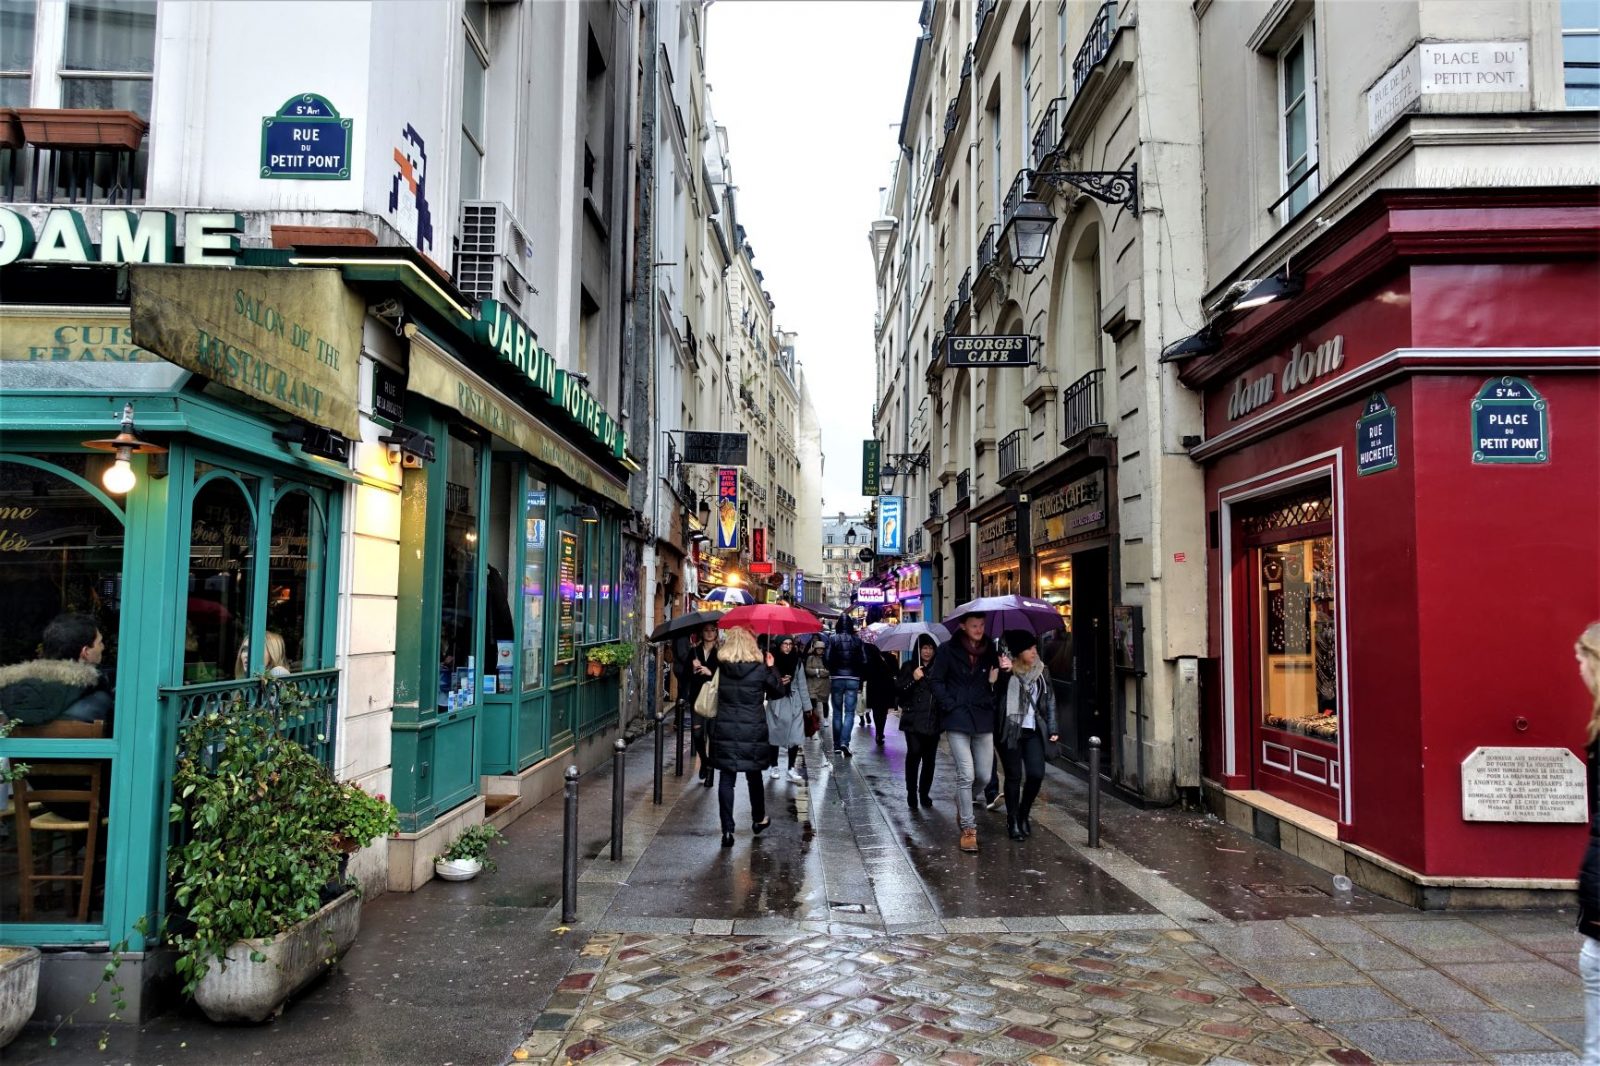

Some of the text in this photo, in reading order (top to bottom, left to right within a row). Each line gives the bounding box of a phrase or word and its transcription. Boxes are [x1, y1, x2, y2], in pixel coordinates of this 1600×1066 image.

[1434, 51, 1515, 65] PLACE DU
[1374, 64, 1411, 103] RUE DE LA
[1434, 72, 1515, 85] PETIT PONT
[1374, 82, 1413, 123] HUCHETTE
[293, 128, 320, 141] RUE
[301, 144, 311, 152] DU
[271, 154, 340, 168] PETIT PONT
[234, 288, 340, 372] SALON DE THE
[953, 338, 1023, 351] GEORGES
[967, 351, 1009, 362] CAFE
[198, 329, 323, 417] RESTAURANT
[488, 301, 557, 398] JARDIN
[561, 373, 601, 438] NOTRE
[1227, 334, 1345, 421] dam dom
[384, 380, 397, 397] RUE
[1489, 414, 1529, 425] PLACE
[1369, 424, 1383, 439] RUE
[1480, 438, 1539, 449] PETIT PONT
[1360, 444, 1394, 464] HUCHETTE
